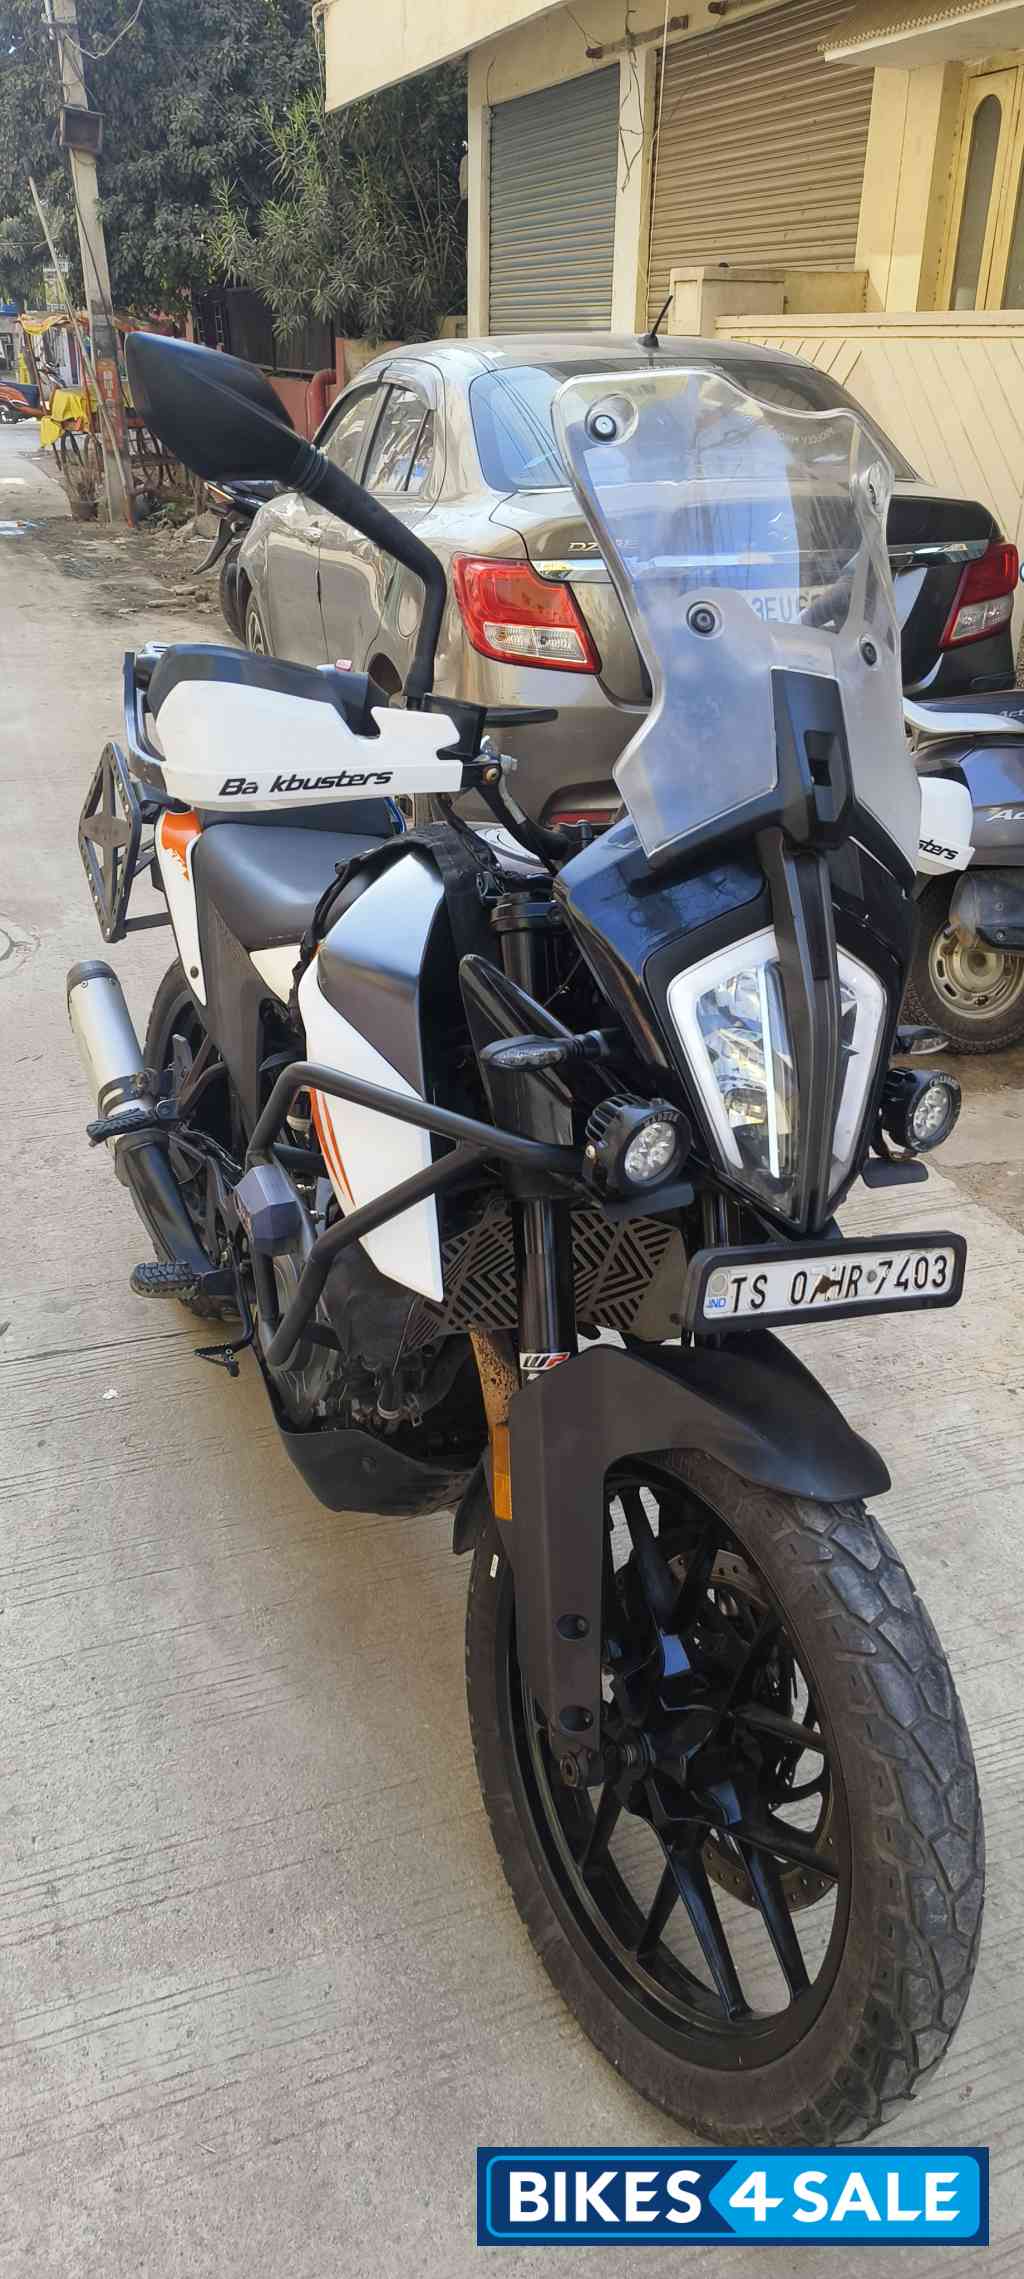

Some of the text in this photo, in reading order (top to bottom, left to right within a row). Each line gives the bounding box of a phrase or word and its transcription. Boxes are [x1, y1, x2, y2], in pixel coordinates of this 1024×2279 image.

[218, 770, 394, 797] Bakbusters
[730, 1273, 768, 1313] TS
[874, 1254, 948, 1295] 7403
